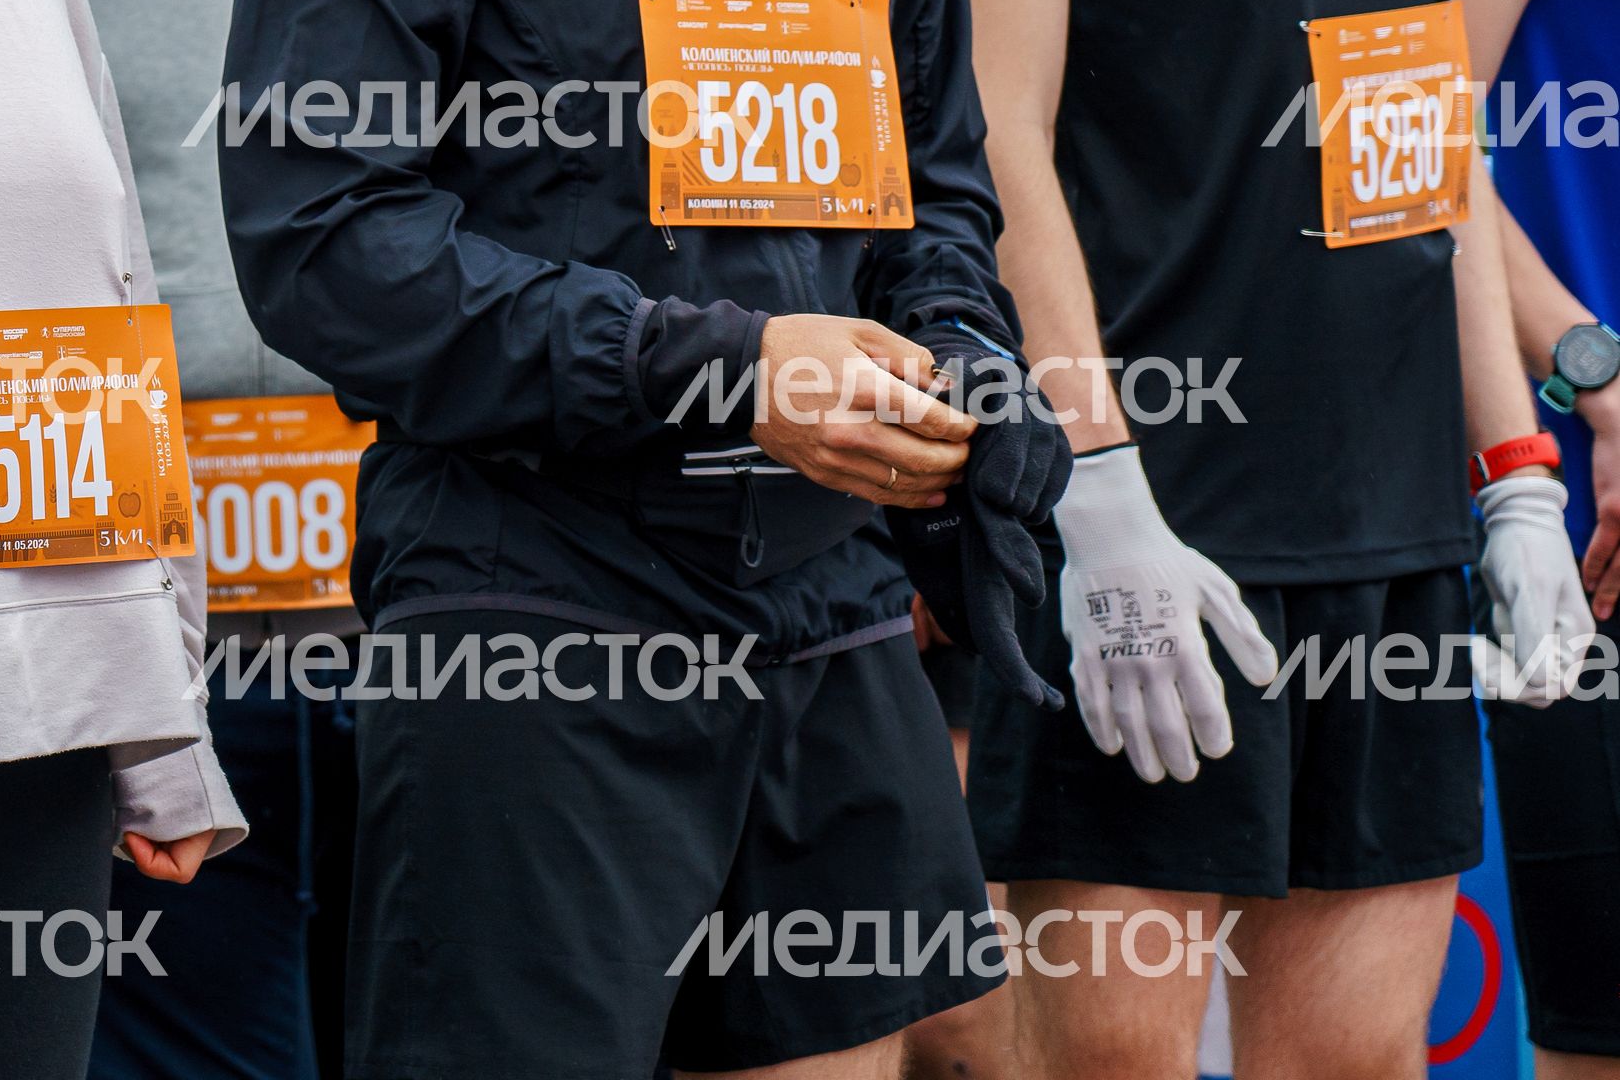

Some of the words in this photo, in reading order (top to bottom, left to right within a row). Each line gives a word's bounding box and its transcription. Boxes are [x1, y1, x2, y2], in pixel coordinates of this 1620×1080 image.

[681, 47, 770, 63] КОЛОМЕНСКИЙ
[773, 49, 861, 67] ПОЛУМАРАФОН
[697, 80, 841, 185] 5218
[1349, 95, 1444, 203] 5250
[50, 374, 138, 394] ПОЛУМАРАФОН
[99, 531, 111, 547] 5
[1100, 638, 1175, 660] ULTIMA
